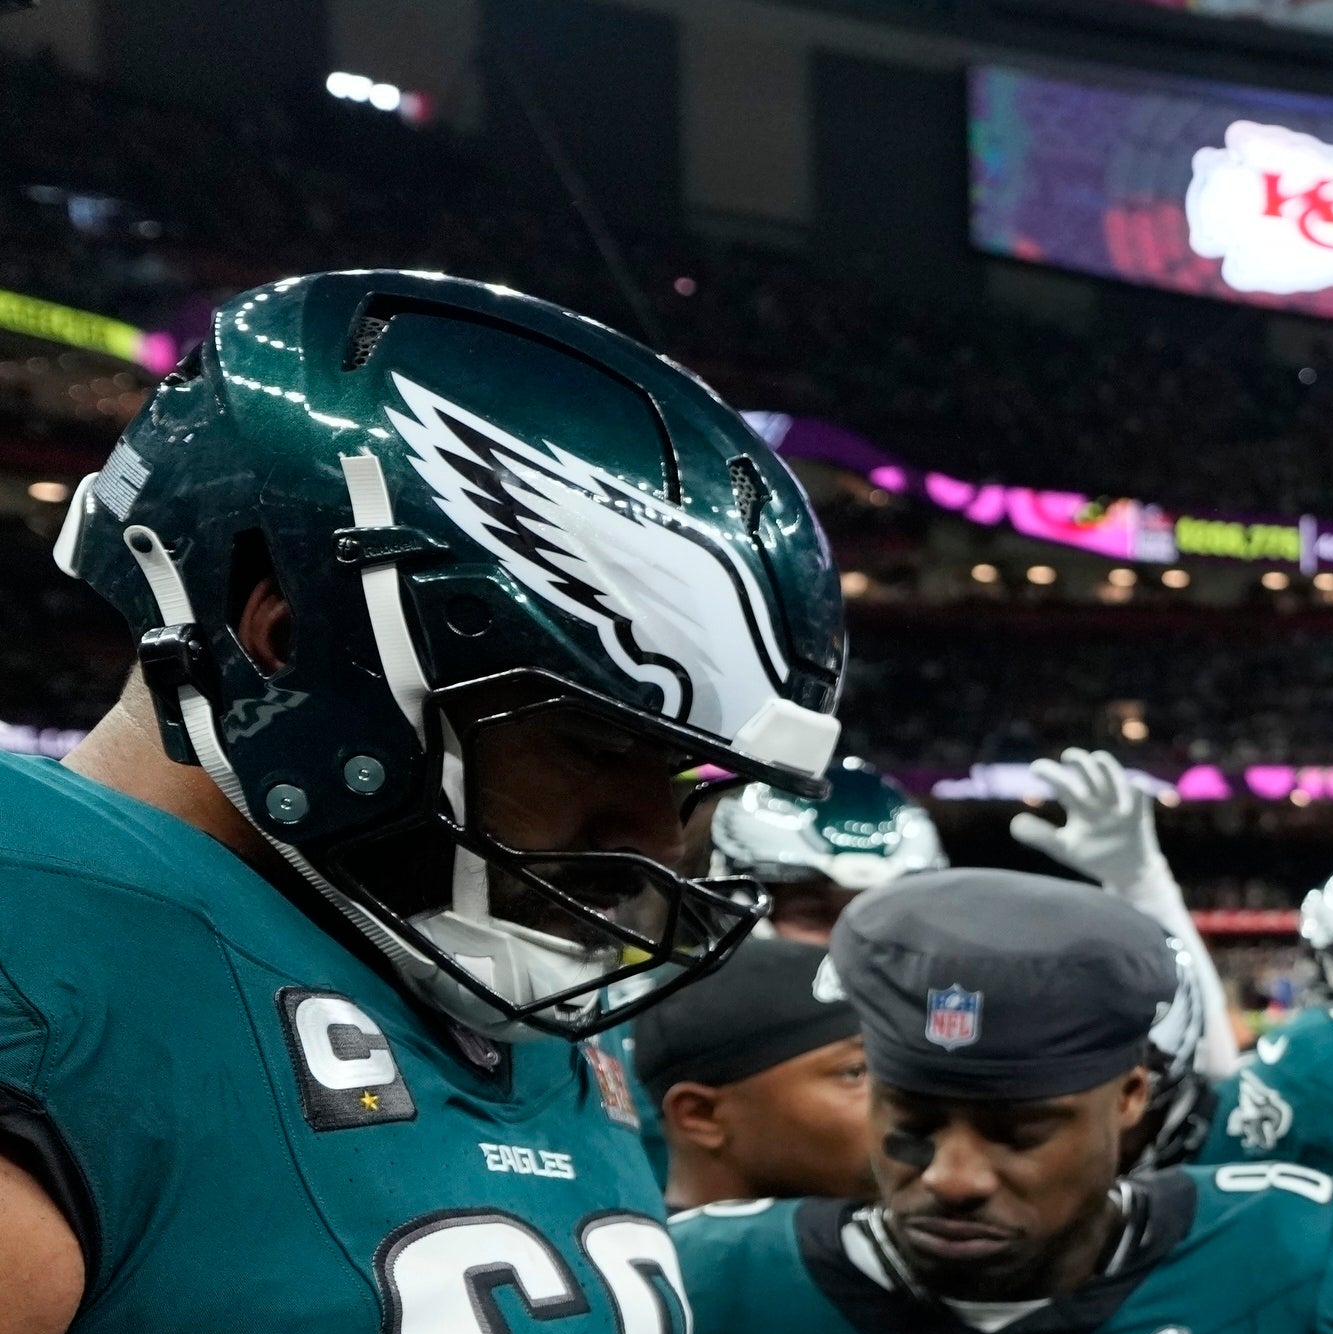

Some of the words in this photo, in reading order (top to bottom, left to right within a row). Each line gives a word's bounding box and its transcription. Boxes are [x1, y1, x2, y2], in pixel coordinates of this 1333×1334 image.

[933, 1010, 972, 1038] NFL
[295, 997, 397, 1090] C
[478, 1143, 577, 1180] EAGLES
